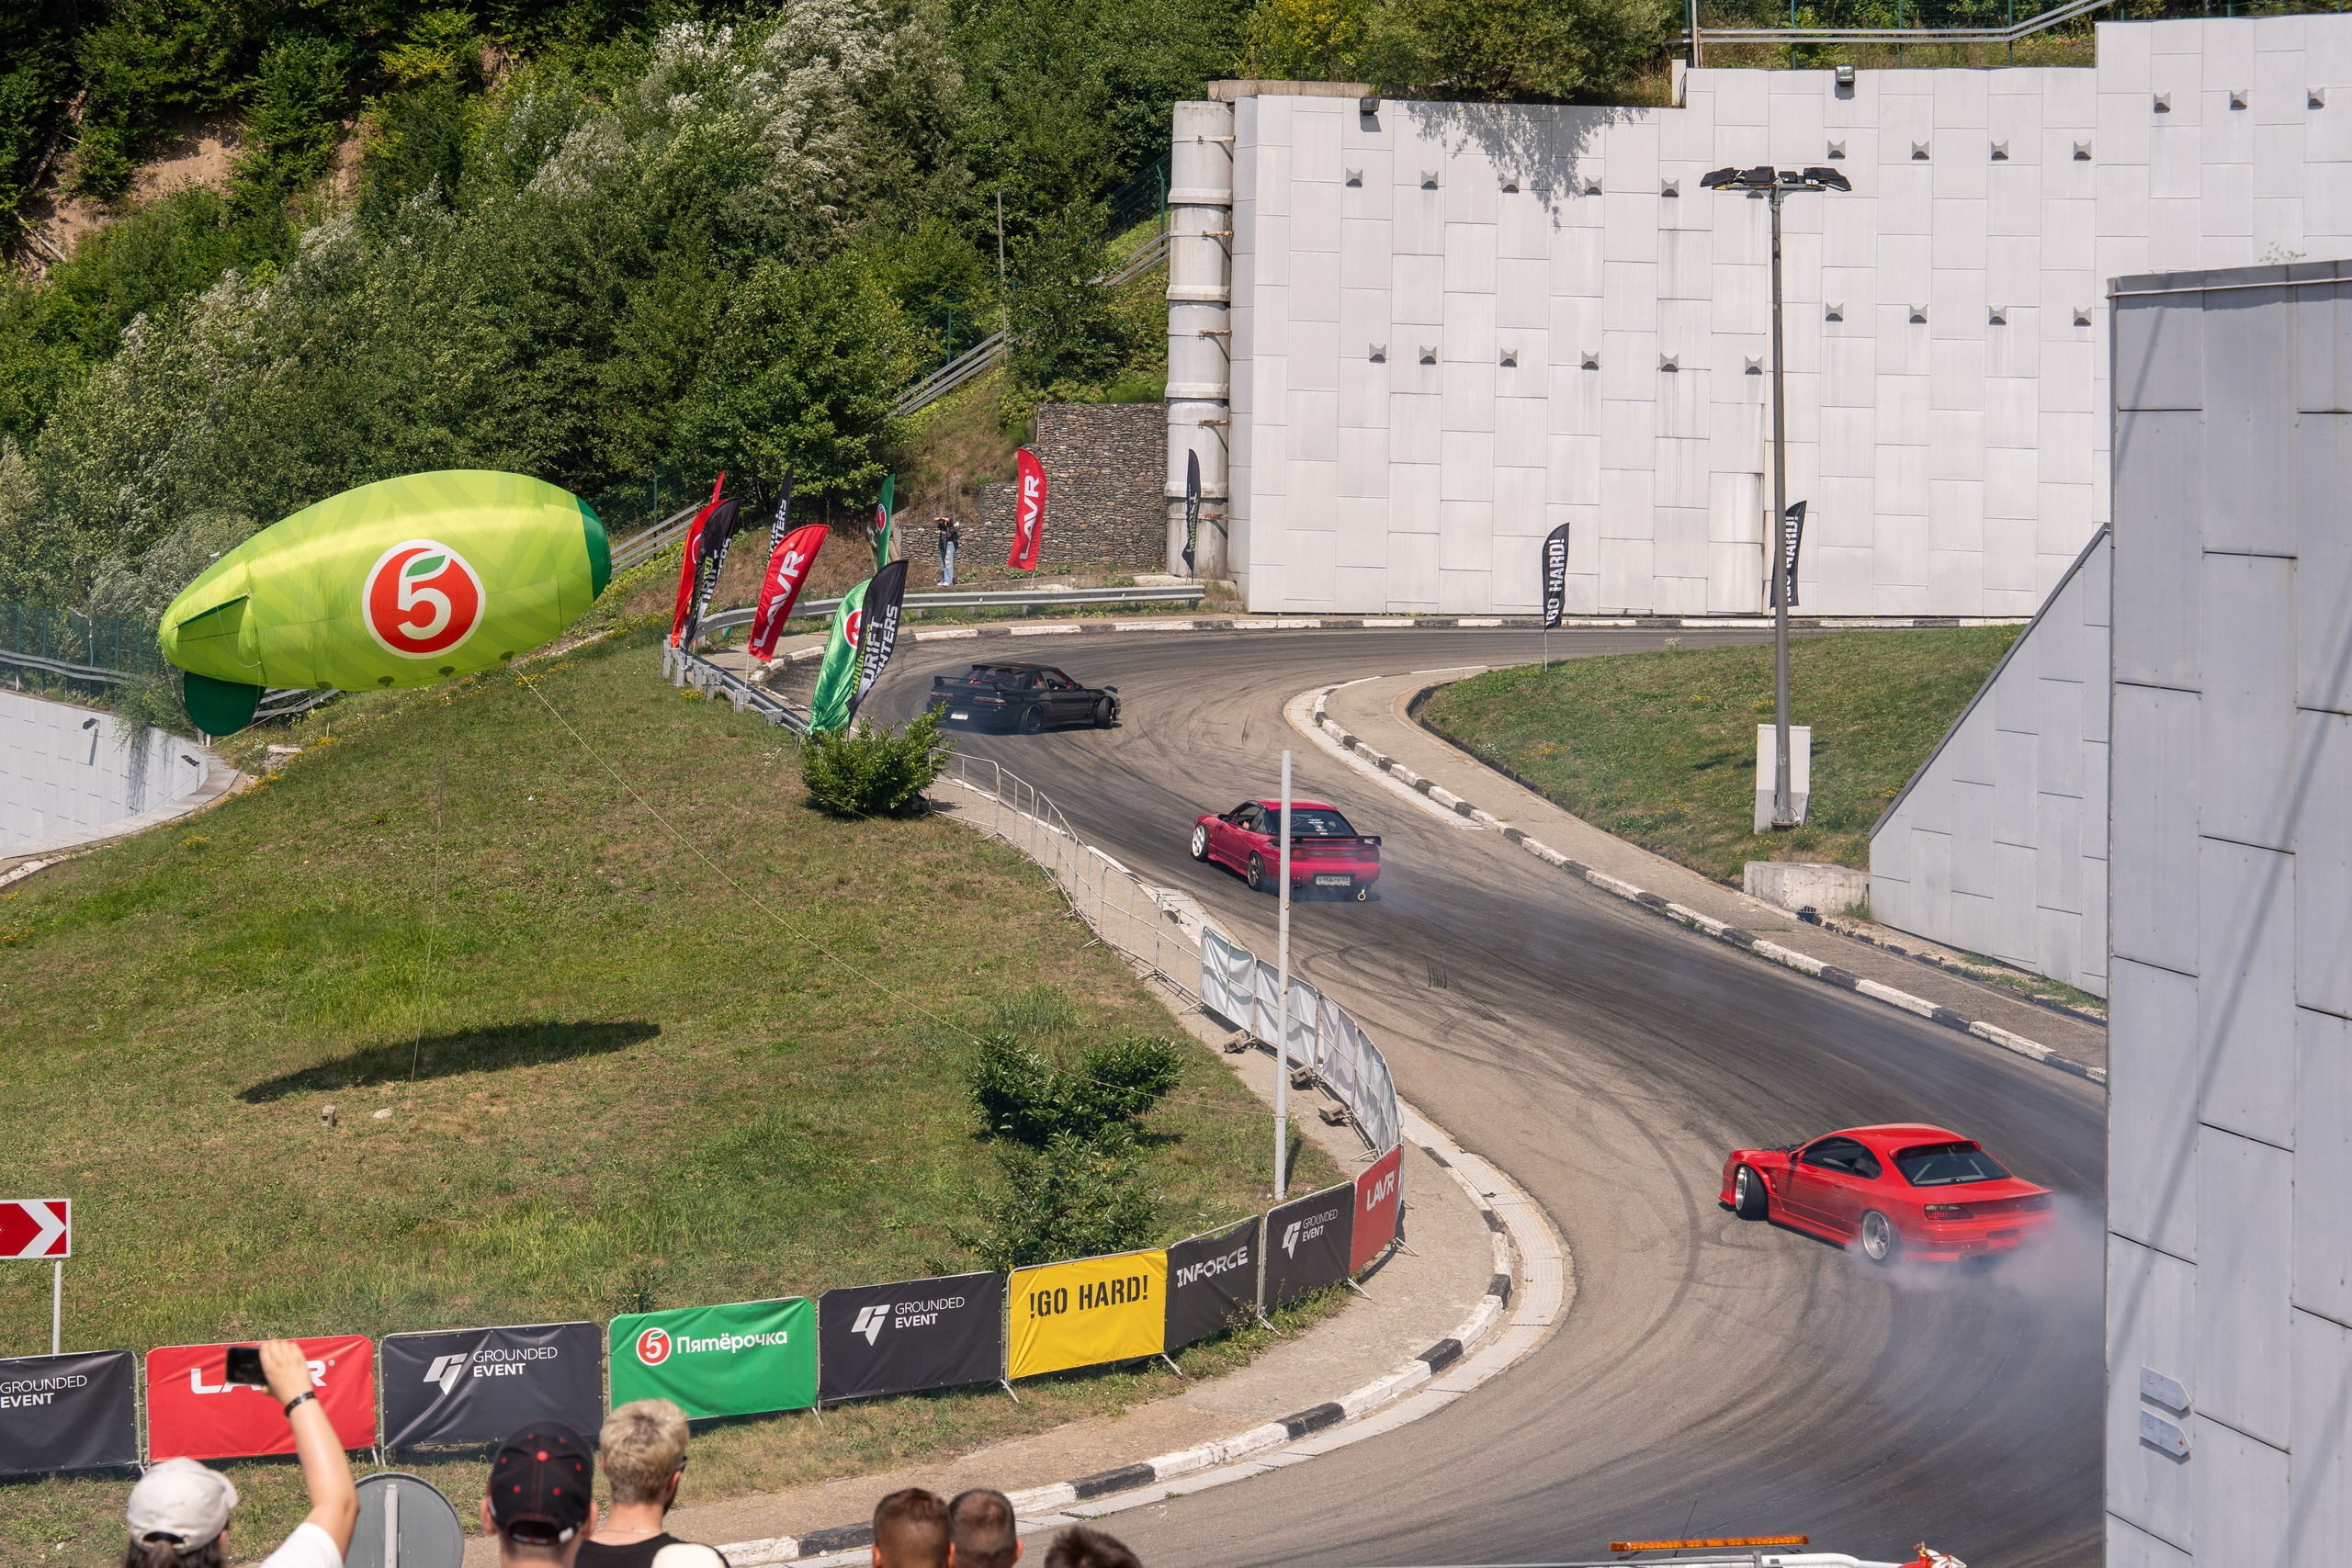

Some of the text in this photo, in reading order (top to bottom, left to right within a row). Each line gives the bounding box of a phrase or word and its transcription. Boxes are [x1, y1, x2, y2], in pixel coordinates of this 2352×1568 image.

[1019, 475, 1039, 560] LAVR
[1549, 538, 1566, 592] HARD!
[753, 550, 806, 648] LAVR
[863, 616, 884, 681] DRIFT
[1366, 1170, 1395, 1212] LAVR
[1303, 1209, 1339, 1229] GROUNDED
[1303, 1225, 1324, 1242] EVENT
[1176, 1245, 1249, 1288] INFORCE
[895, 1296, 966, 1314] GROUNDED
[1030, 1275, 1148, 1319] !GO HARD!
[895, 1313, 938, 1329] EVENT
[676, 1331, 788, 1354] Пятёрочка
[473, 1347, 558, 1363] GROUNDED
[190, 1359, 327, 1394] LR
[473, 1363, 526, 1377] EVENT
[0, 1375, 87, 1393] GROUNDED
[0, 1393, 54, 1408] EVENT
